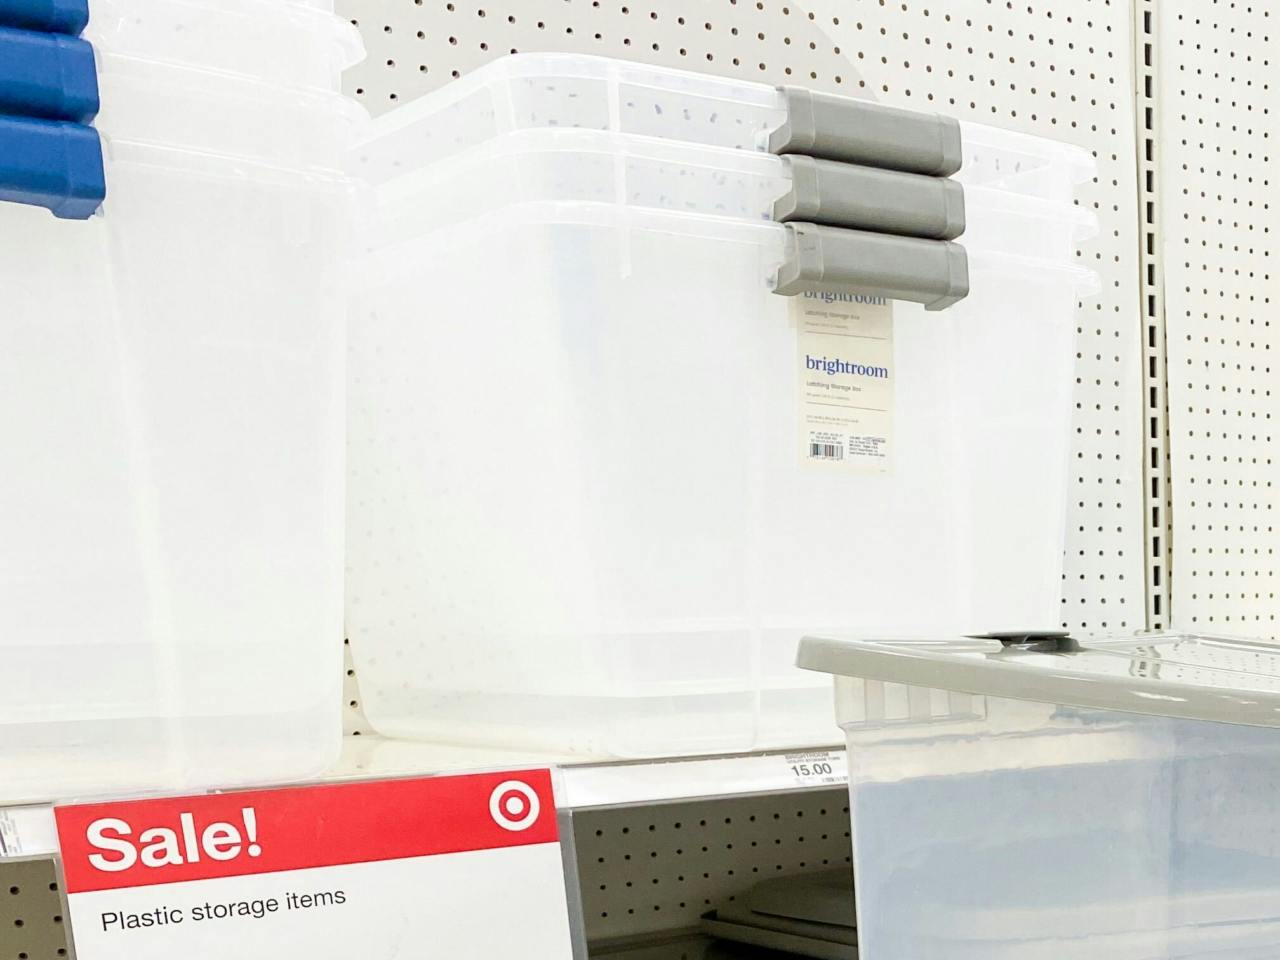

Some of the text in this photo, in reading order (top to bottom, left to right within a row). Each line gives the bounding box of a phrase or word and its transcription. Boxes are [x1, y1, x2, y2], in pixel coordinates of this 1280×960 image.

[806, 354, 888, 378] brightroom
[791, 763, 832, 776] 15.00
[87, 807, 262, 872] Sale!
[101, 888, 347, 932] Plastic storage items
